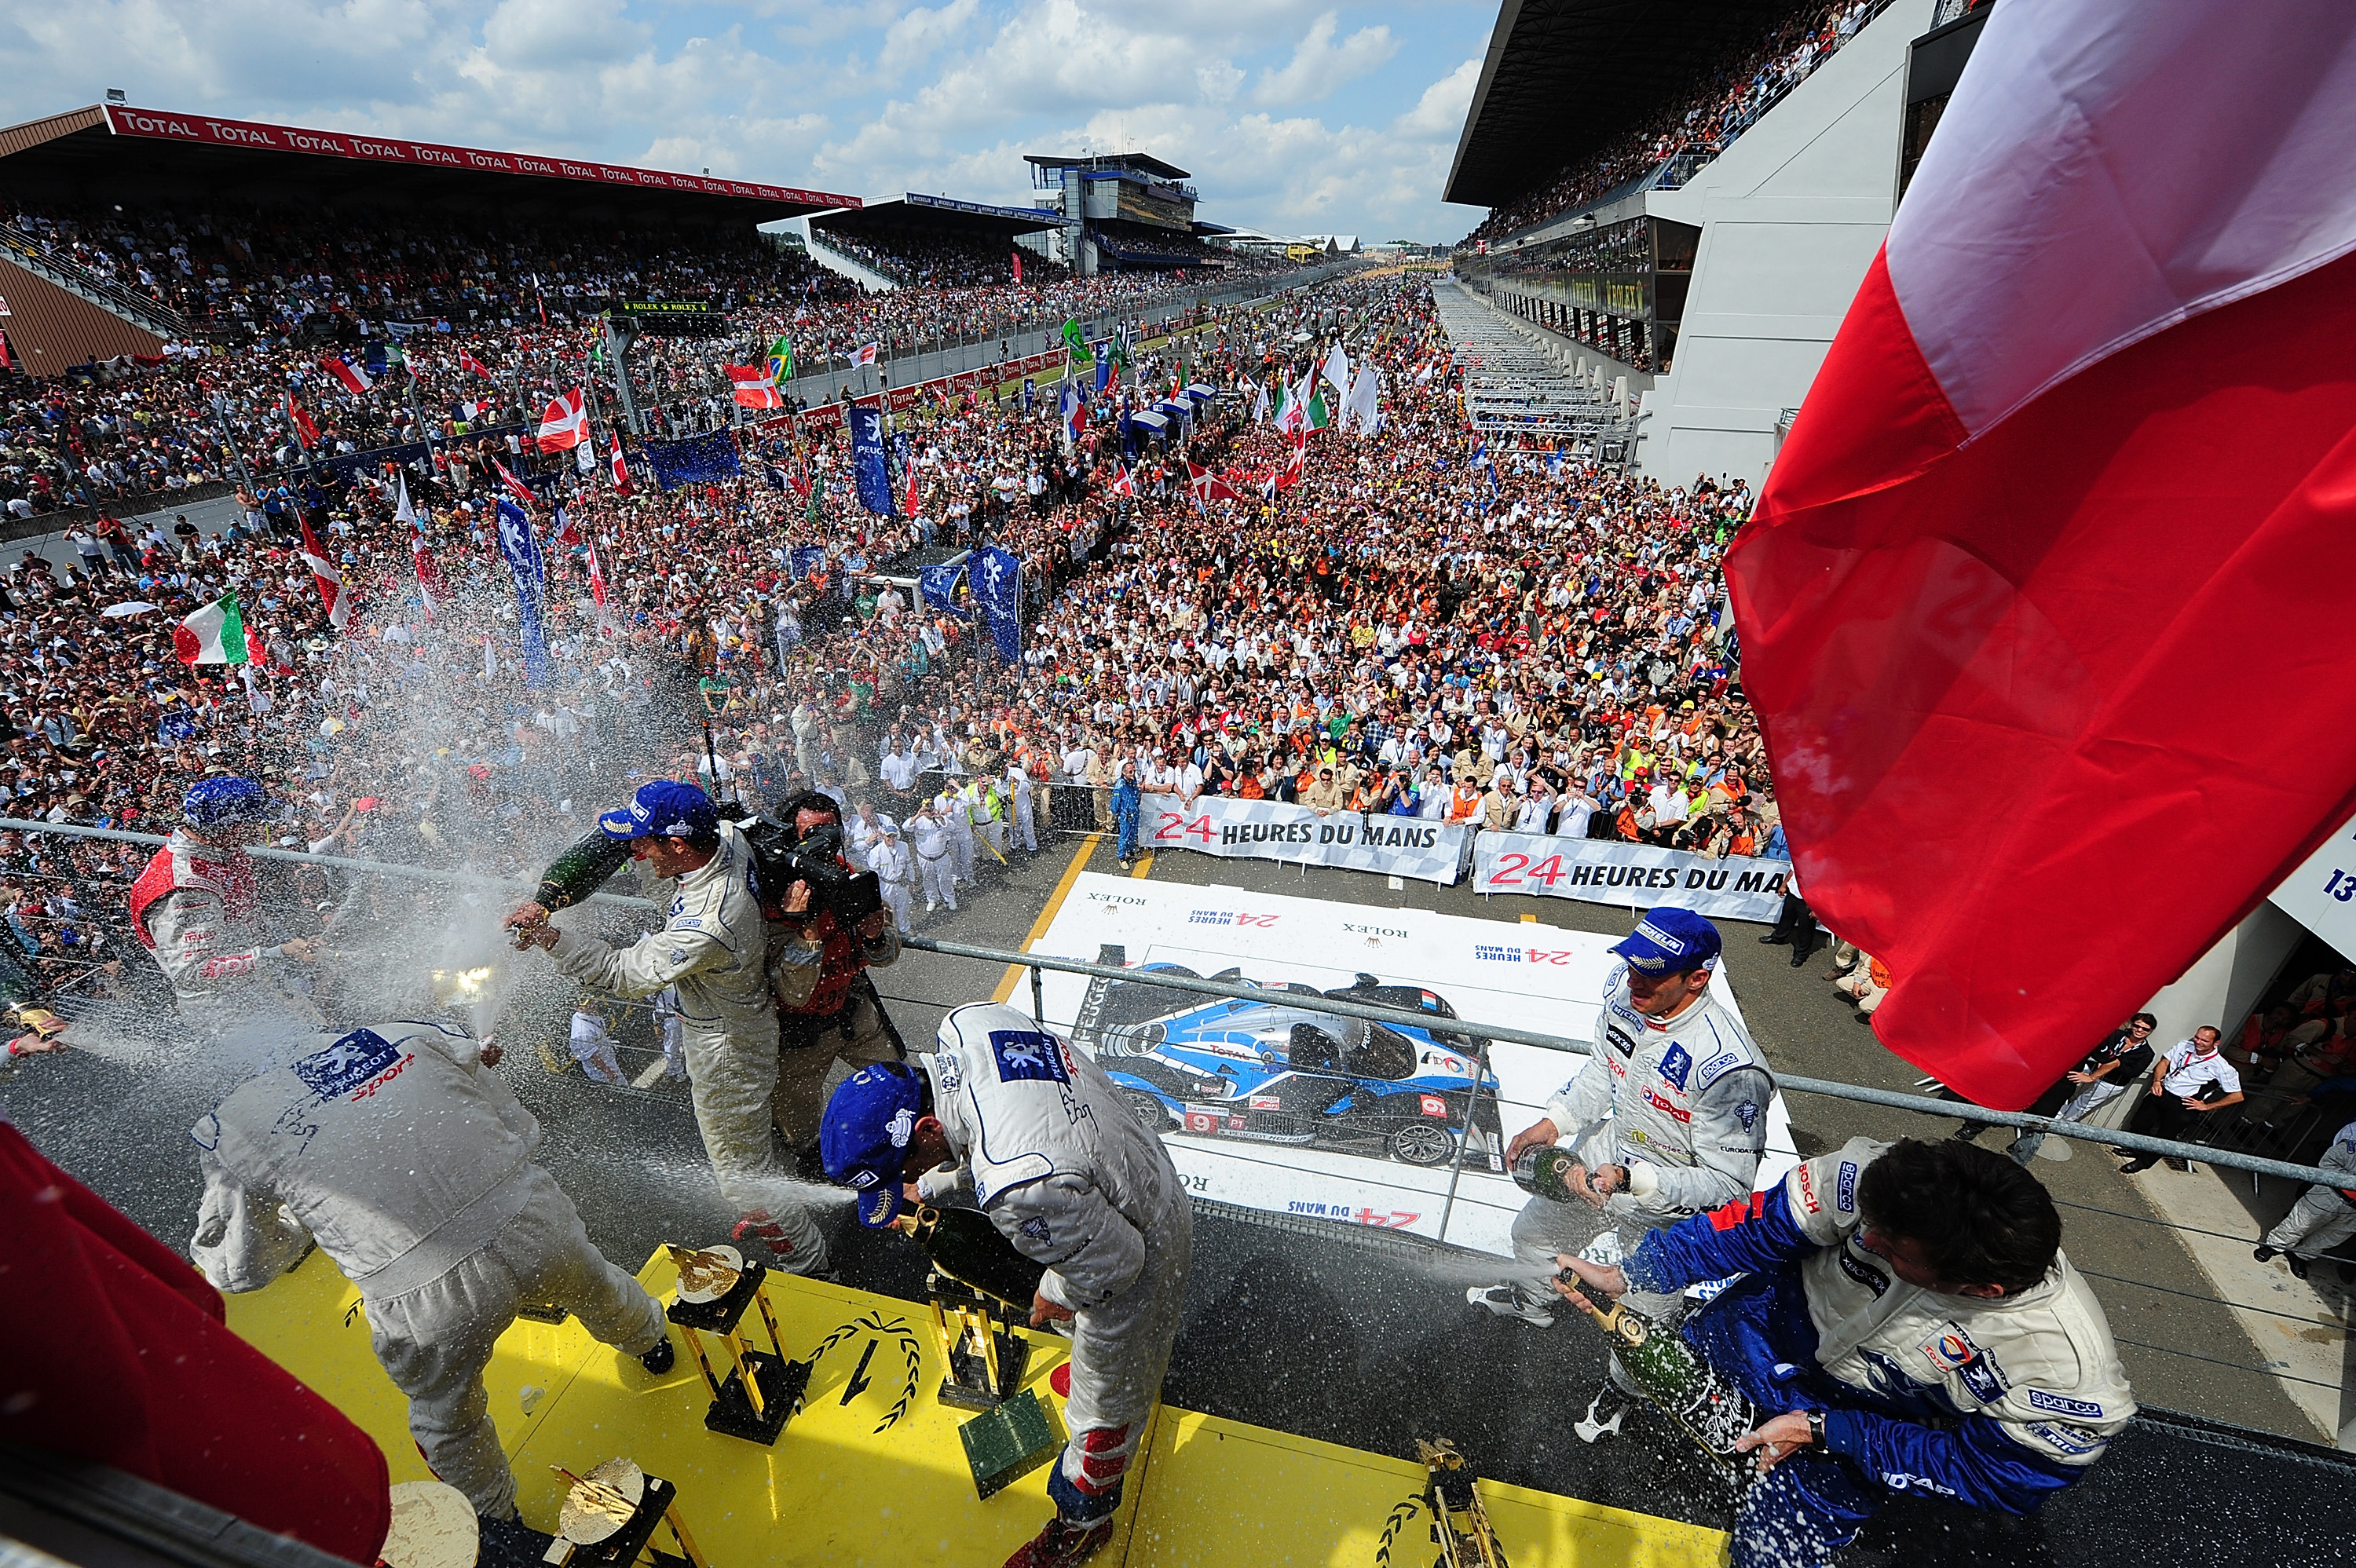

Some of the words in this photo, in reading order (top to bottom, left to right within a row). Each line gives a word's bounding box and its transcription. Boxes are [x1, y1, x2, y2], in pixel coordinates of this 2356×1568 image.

[1612, 285, 1636, 310] ROLEX
[892, 392, 915, 405] TOTAL
[1005, 365, 1020, 376] TOTAL
[1026, 359, 1040, 368] TOTAL
[1154, 812, 1218, 843] 24
[1222, 823, 1312, 845] HEURES
[1319, 825, 1354, 845] DU
[1361, 825, 1437, 848] MANS
[1490, 853, 1566, 885] 24
[1571, 865, 1679, 889] HEURES
[1684, 869, 1729, 890] DU
[1733, 871, 1784, 893] MA
[1087, 892, 1147, 906] ROLEX
[1188, 916, 1231, 925] HEURES
[1236, 913, 1280, 928] 24
[1343, 923, 1409, 938] ROLEX
[1639, 921, 1680, 950] MICHELIN
[1476, 952, 1521, 962] HEURES
[1525, 948, 1573, 965] 24
[1076, 976, 1110, 1040] PEUGE
[1361, 1019, 1369, 1049] PEUGEO
[1042, 1037, 1062, 1078] PEUGEOT
[1210, 1044, 1249, 1060] TOTAL
[352, 1053, 415, 1102] sport
[1662, 1079, 1687, 1098] sport
[1423, 1099, 1445, 1114] 9
[1655, 1098, 1688, 1122] TOTAL
[1193, 1115, 1210, 1131] 9
[1230, 1120, 1243, 1128] P1
[1229, 1131, 1268, 1140] PEUGEOT
[1178, 1174, 1210, 1191] RO
[1799, 1163, 1821, 1214] BOSCH
[1288, 1201, 1326, 1215] MANS
[1331, 1205, 1350, 1217] DU
[1843, 1257, 1868, 1278] XBOX
[1925, 1345, 1950, 1372] TOTA
[1960, 1367, 1986, 1399] PEUGEOT
